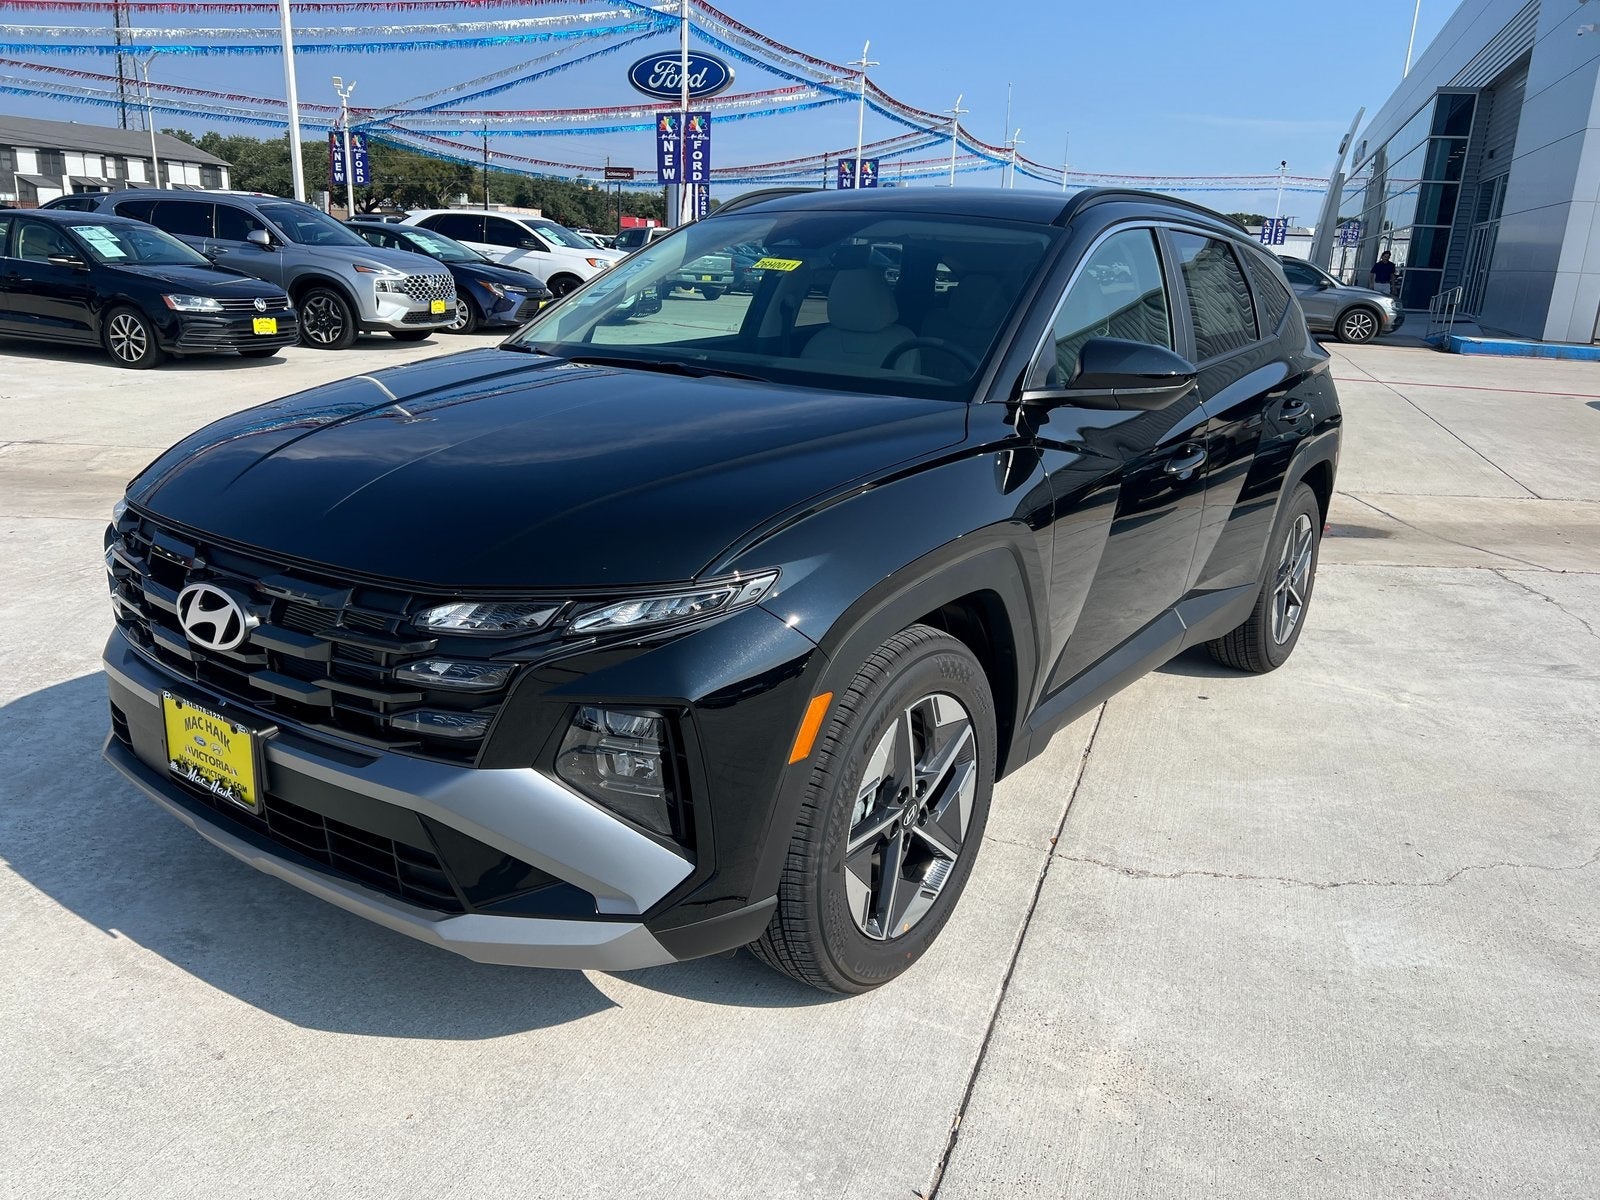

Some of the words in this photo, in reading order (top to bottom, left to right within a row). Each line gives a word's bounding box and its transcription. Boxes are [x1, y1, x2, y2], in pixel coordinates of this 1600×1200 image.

[648, 60, 708, 88] Ford
[334, 152, 344, 182] NEW
[355, 153, 365, 183] FORD
[662, 140, 676, 180] NEW
[692, 140, 703, 181] FORD
[1262, 229, 1270, 244] NEW
[184, 715, 204, 731] MAC
[205, 719, 232, 753] HAIK
[190, 746, 230, 772] VICTORIA
